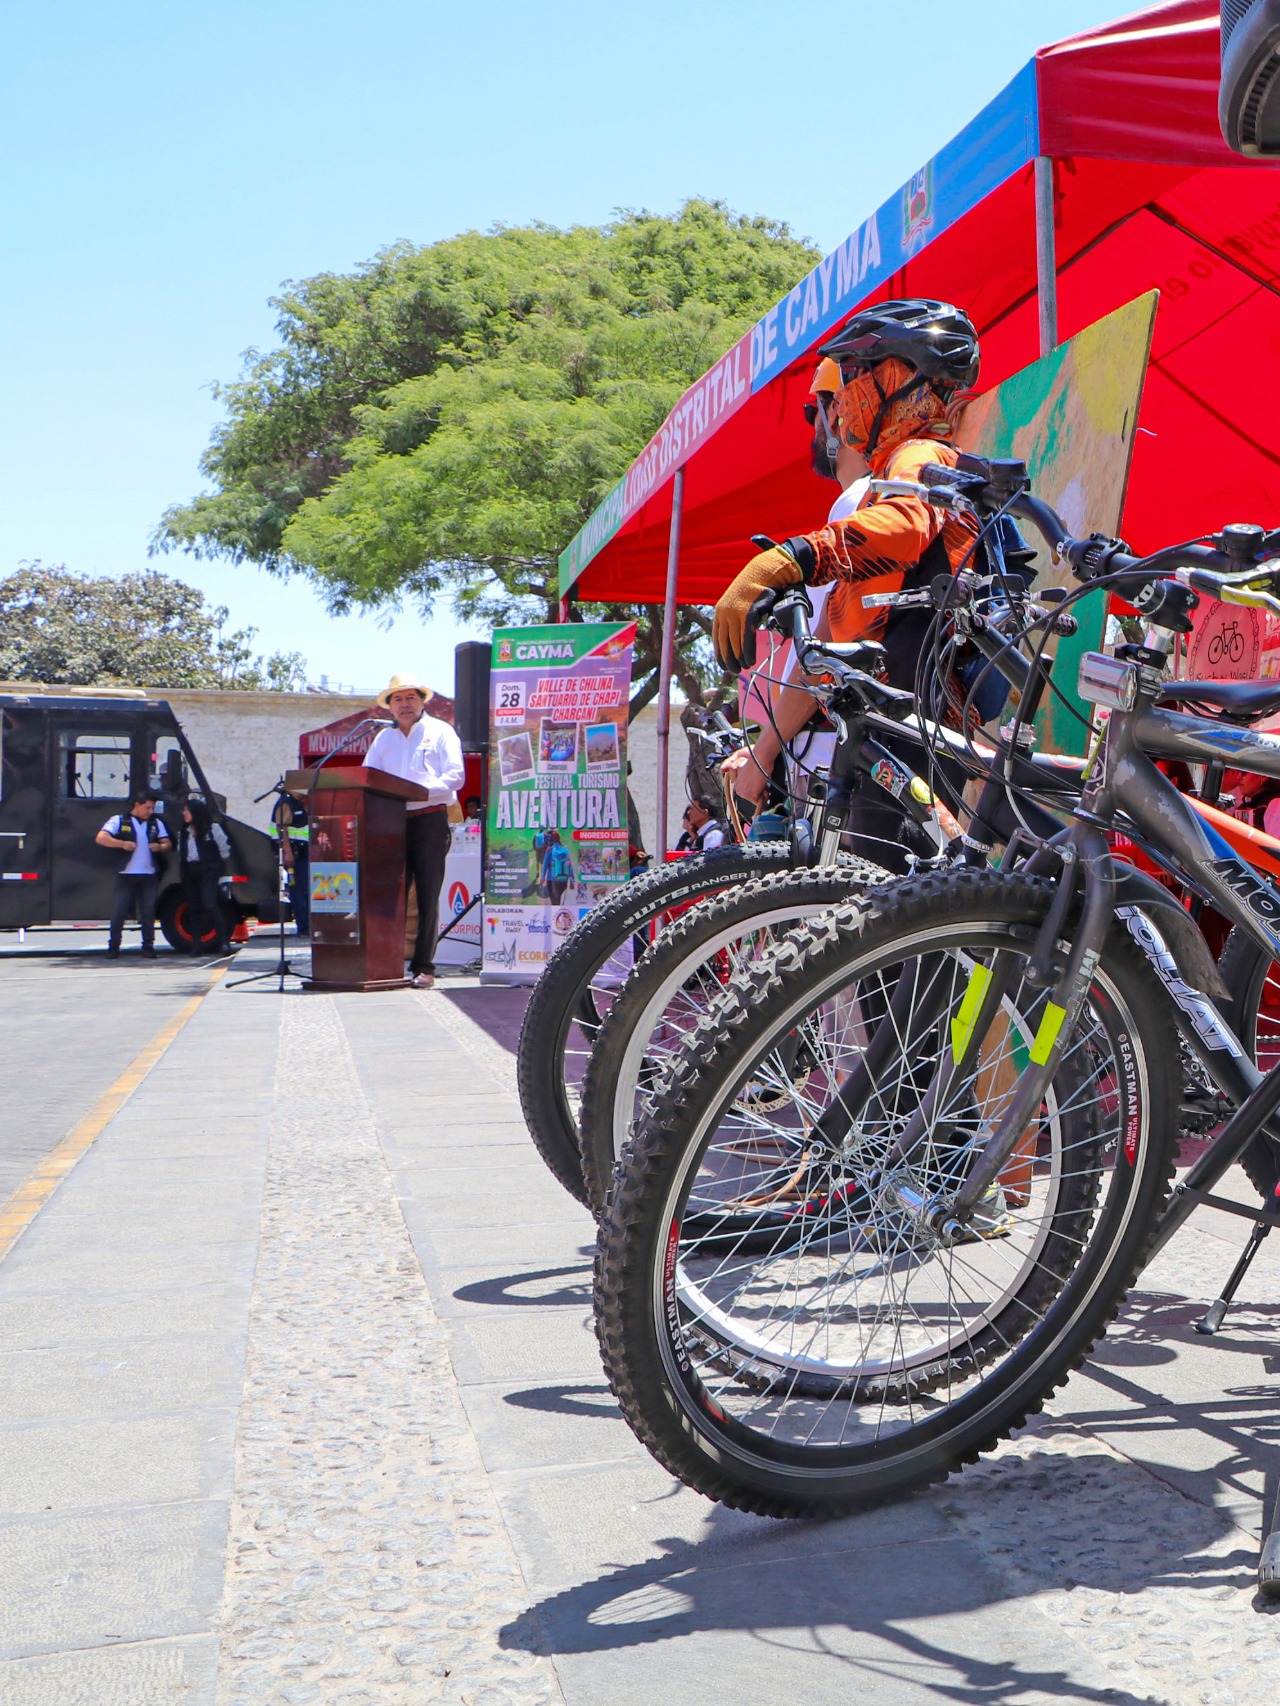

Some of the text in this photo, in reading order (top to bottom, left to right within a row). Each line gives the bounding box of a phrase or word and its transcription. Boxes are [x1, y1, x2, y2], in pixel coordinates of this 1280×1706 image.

[658, 346, 746, 476] DISTRITAL
[749, 308, 778, 383] DE
[784, 211, 881, 348] CAYMA
[516, 645, 574, 659] CAYMA
[538, 677, 613, 692] VALLE DE CHILINA
[500, 693, 520, 707] 28
[529, 692, 620, 708] SANTUARIO DE CHAPI
[553, 707, 597, 721] CHARCANI
[535, 773, 619, 789] FESTIVAL TURISMO
[496, 789, 620, 829] AVENTURA
[633, 872, 748, 920] WTB RANGER
[1119, 1043, 1138, 1116] EASTMAN
[1125, 1120, 1133, 1147] POWER
[1129, 1117, 1138, 1151] ULTIMATE
[665, 1279, 685, 1363] EASTMAN
